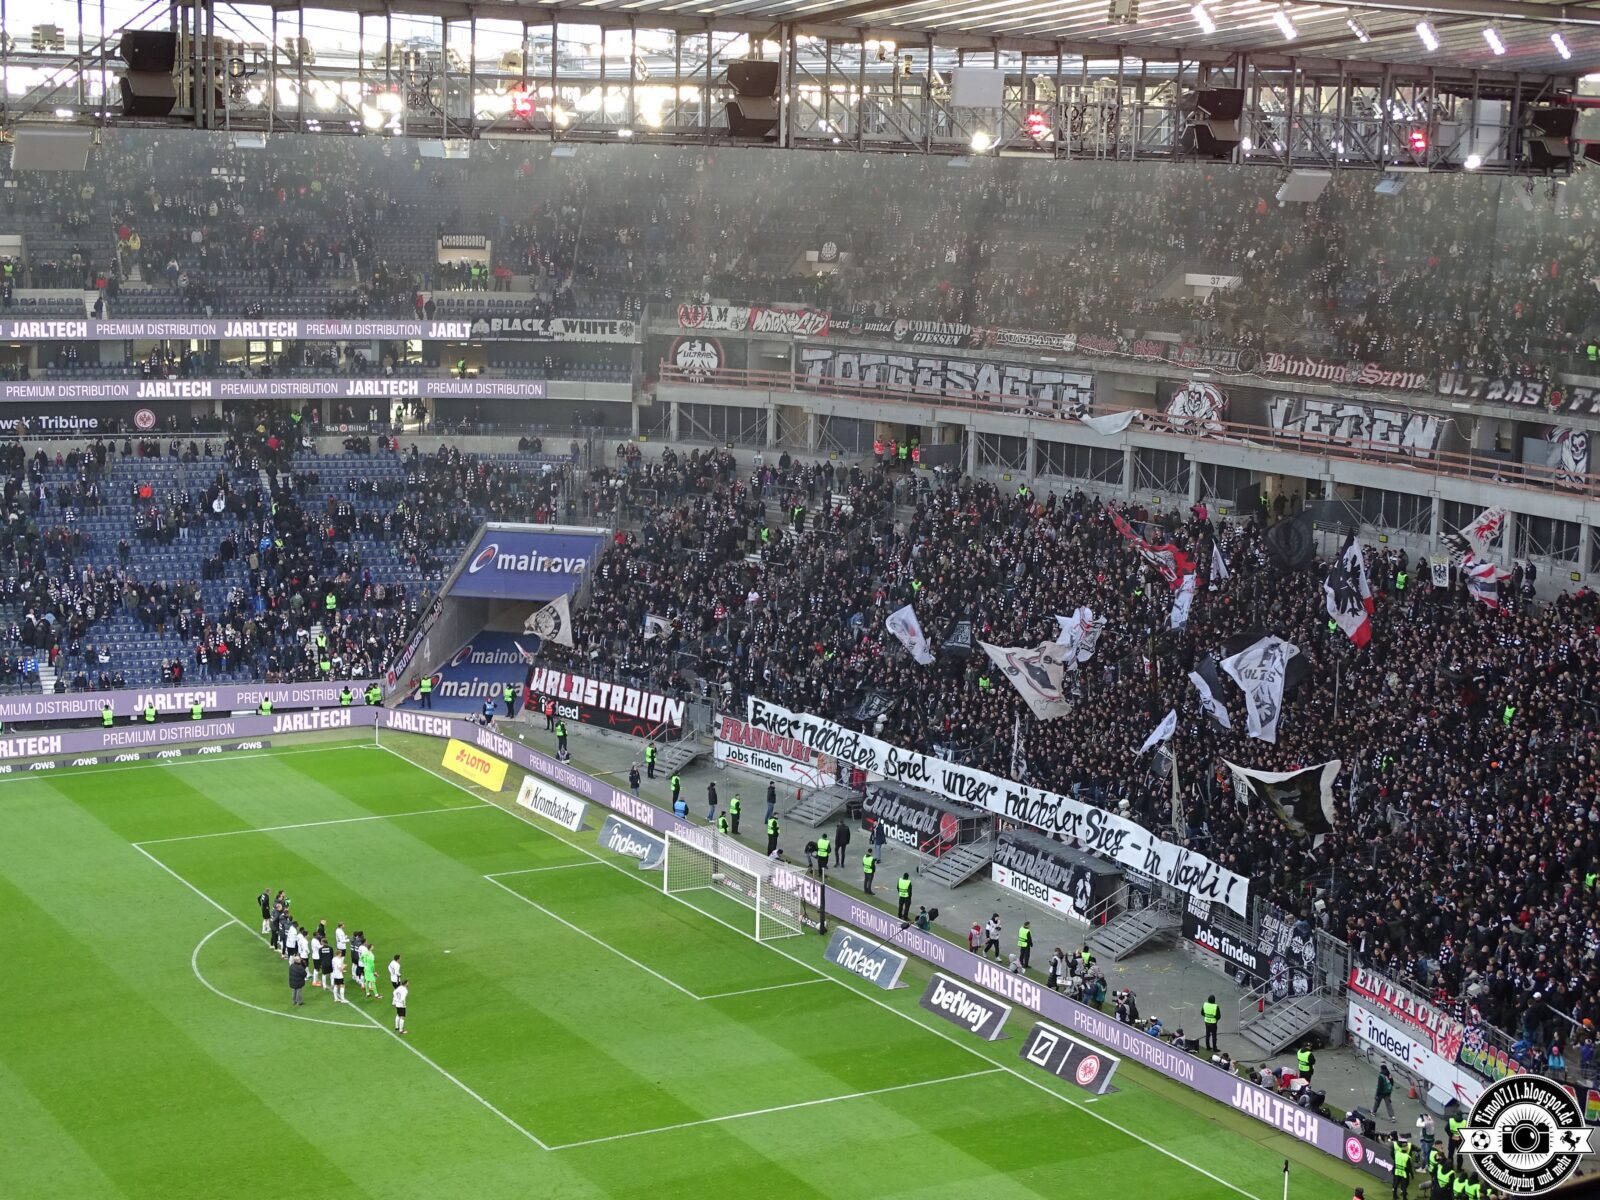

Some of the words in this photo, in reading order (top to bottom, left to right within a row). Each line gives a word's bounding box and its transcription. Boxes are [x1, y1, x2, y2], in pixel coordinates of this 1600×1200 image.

[11, 322, 87, 338] JARLTECH
[96, 323, 144, 336] PREMIUM
[147, 323, 216, 336] DISTRIBUTION
[224, 321, 297, 338] JARLTECH
[306, 323, 352, 336] PREMIUM
[355, 323, 422, 336] DISTRIBUTION
[491, 318, 545, 332] BLACK
[562, 319, 618, 334] WHITE
[830, 320, 850, 329] west
[865, 320, 894, 332] united
[908, 319, 971, 335] COMMANDO
[913, 333, 961, 346] GIESSEN
[1265, 352, 1348, 383] Binding
[1357, 363, 1425, 389] Szene
[6, 385, 55, 397] PREMIUM
[58, 384, 129, 396] DISTRIBUTION
[136, 381, 212, 398] JARLTECH
[221, 383, 268, 395] PREMIUM
[271, 383, 338, 395] DISTRIBUTION
[346, 380, 418, 395] JARLTECH
[427, 383, 474, 395] PREMIUM
[475, 383, 542, 395] DISTRIBUTION
[39, 415, 98, 429] Tribüne
[1270, 397, 1445, 458] LEBEN
[497, 551, 588, 573] mainova
[36, 698, 114, 715] DISTRIBUTION
[134, 691, 217, 712] JARLTECH
[237, 691, 289, 704] PREMIUM
[530, 667, 685, 728] WALDSTADION
[103, 730, 156, 746] PREMIUM
[160, 723, 235, 741] DISTRIBUTION
[273, 709, 351, 733] JARLTECH
[203, 745, 223, 755] DWS
[243, 741, 263, 750] DWS
[720, 717, 811, 763] FRANKFURT
[35, 761, 55, 770] DWS
[78, 757, 98, 766] DWS
[120, 753, 140, 762] DWS
[162, 749, 182, 758] DWS
[466, 754, 491, 774] LOTTO
[726, 747, 749, 762] Jobs
[751, 752, 783, 774] finden
[751, 700, 800, 738] Euer
[942, 770, 998, 807] unser
[1005, 787, 1082, 838] nächster
[1086, 808, 1131, 857] Sieg
[1144, 836, 1161, 875] in
[531, 787, 577, 826] Krombacher
[863, 785, 939, 835] Eintracht
[1011, 871, 1049, 903] indeed
[387, 713, 451, 737] JARLTECH
[477, 728, 513, 760] JARLTECH
[530, 754, 554, 777] PREMIUM
[555, 764, 592, 796] DISTRIBUTION
[611, 791, 654, 827] JARLTECH
[851, 905, 888, 936] PREMIUM
[889, 922, 946, 963] DISTRIBUTION
[974, 961, 1041, 1012] JARLTECH
[1074, 1010, 1121, 1046] PREMIUM
[1123, 1033, 1194, 1082] DISTRIBUTION
[1232, 1082, 1318, 1145] JARLTECH
[1194, 924, 1219, 950] Jobs
[1221, 936, 1257, 970] finden
[836, 937, 887, 982] indeed
[930, 979, 993, 1032] betway
[1355, 967, 1450, 1038] EINTRACHT
[1366, 1015, 1411, 1063] indeed
